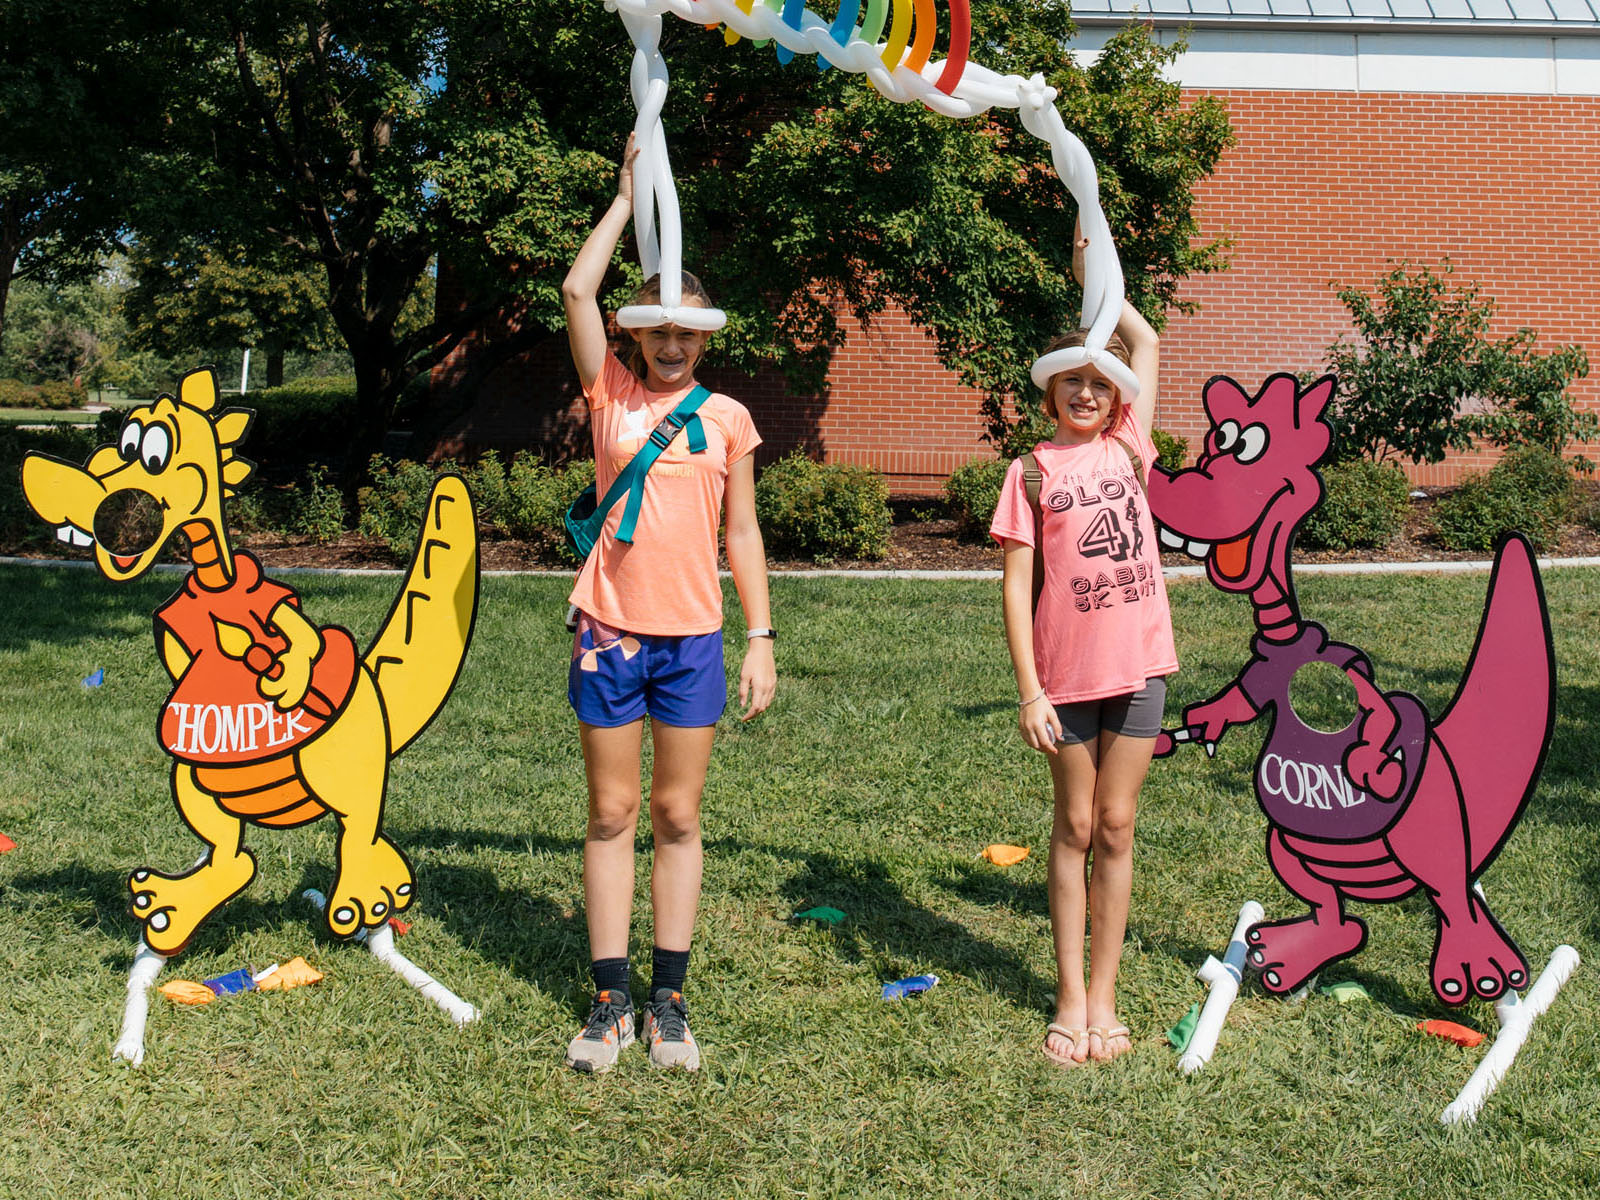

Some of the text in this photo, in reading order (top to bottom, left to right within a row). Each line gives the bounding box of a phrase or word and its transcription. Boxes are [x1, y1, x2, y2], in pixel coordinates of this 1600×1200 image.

[1062, 472, 1085, 488] 4th
[1077, 508, 1130, 562] 4
[1071, 561, 1154, 594] GABBY
[1075, 591, 1114, 613] 5K
